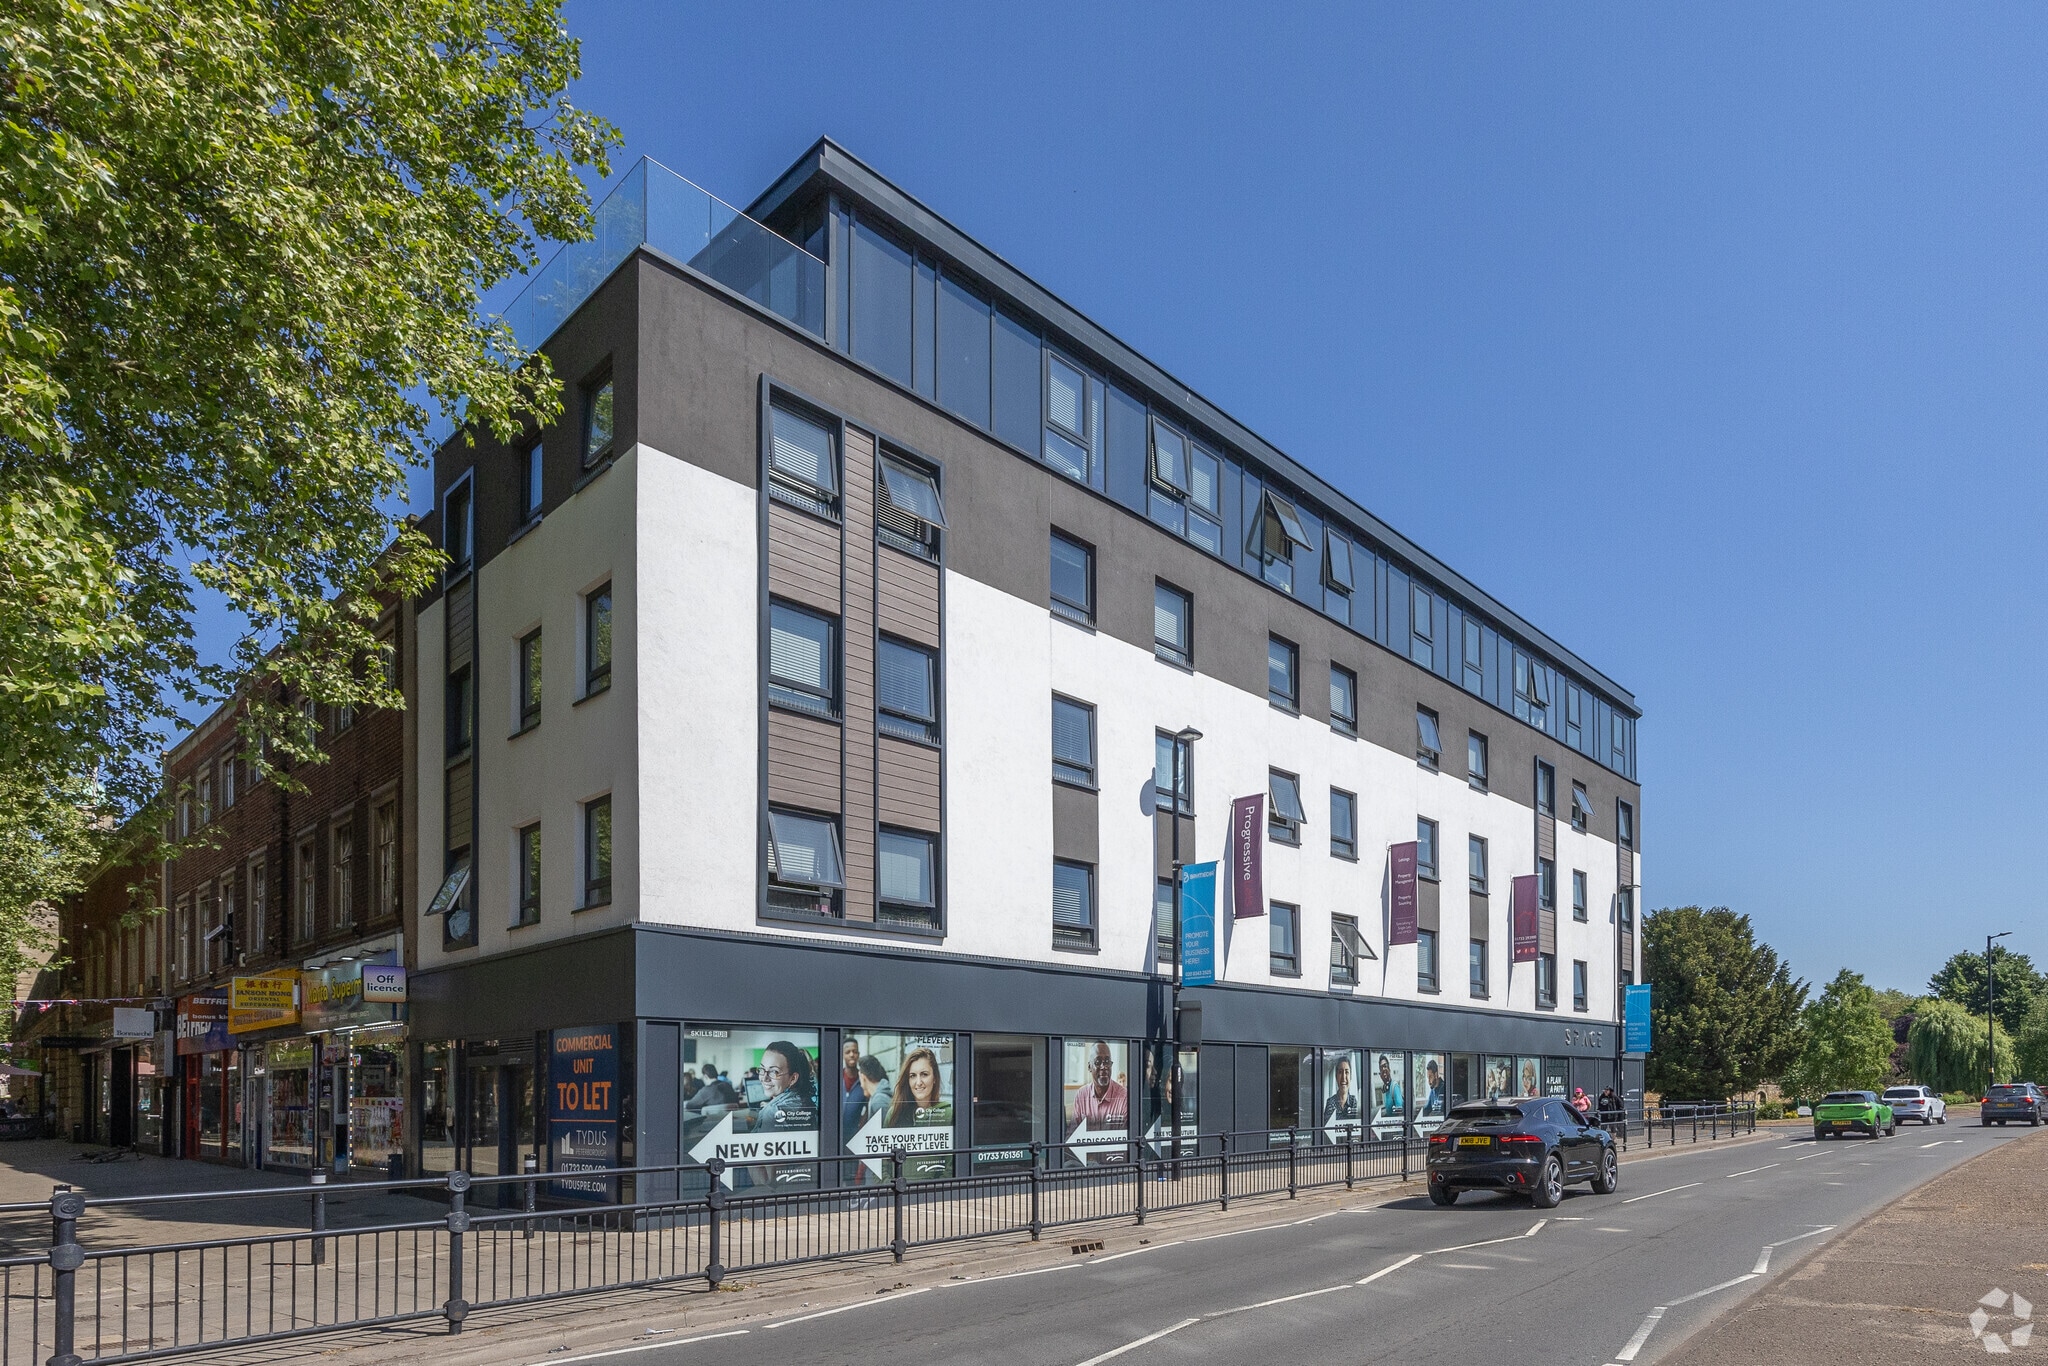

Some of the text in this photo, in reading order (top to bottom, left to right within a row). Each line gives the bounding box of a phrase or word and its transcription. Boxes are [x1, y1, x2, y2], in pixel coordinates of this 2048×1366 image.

[1241, 805, 1255, 881] Progressive
[1185, 931, 1209, 939] PROMOTE
[1185, 940, 1199, 948] YOUR
[1185, 948, 1210, 957] BUSINESS
[1185, 957, 1200, 965] HERE!
[376, 975, 394, 984] Off
[331, 976, 362, 1005] Superm
[367, 983, 404, 992] licence
[193, 997, 228, 1005] BETFRE
[556, 1034, 613, 1053] COMMERCIAL
[1564, 1028, 1603, 1048] SPACE
[573, 1058, 594, 1074] UNIT
[557, 1081, 612, 1111] TO LET
[576, 1130, 607, 1146] TYDUS
[866, 1133, 949, 1145] TAKE YOUR FUTURE
[716, 1141, 811, 1158] NEW SKILL
[866, 1141, 949, 1153] TO THE NEXT LEVEL
[978, 1150, 1024, 1161] 01733 761361
[561, 1179, 607, 1193] TYDUSPRE.COM
